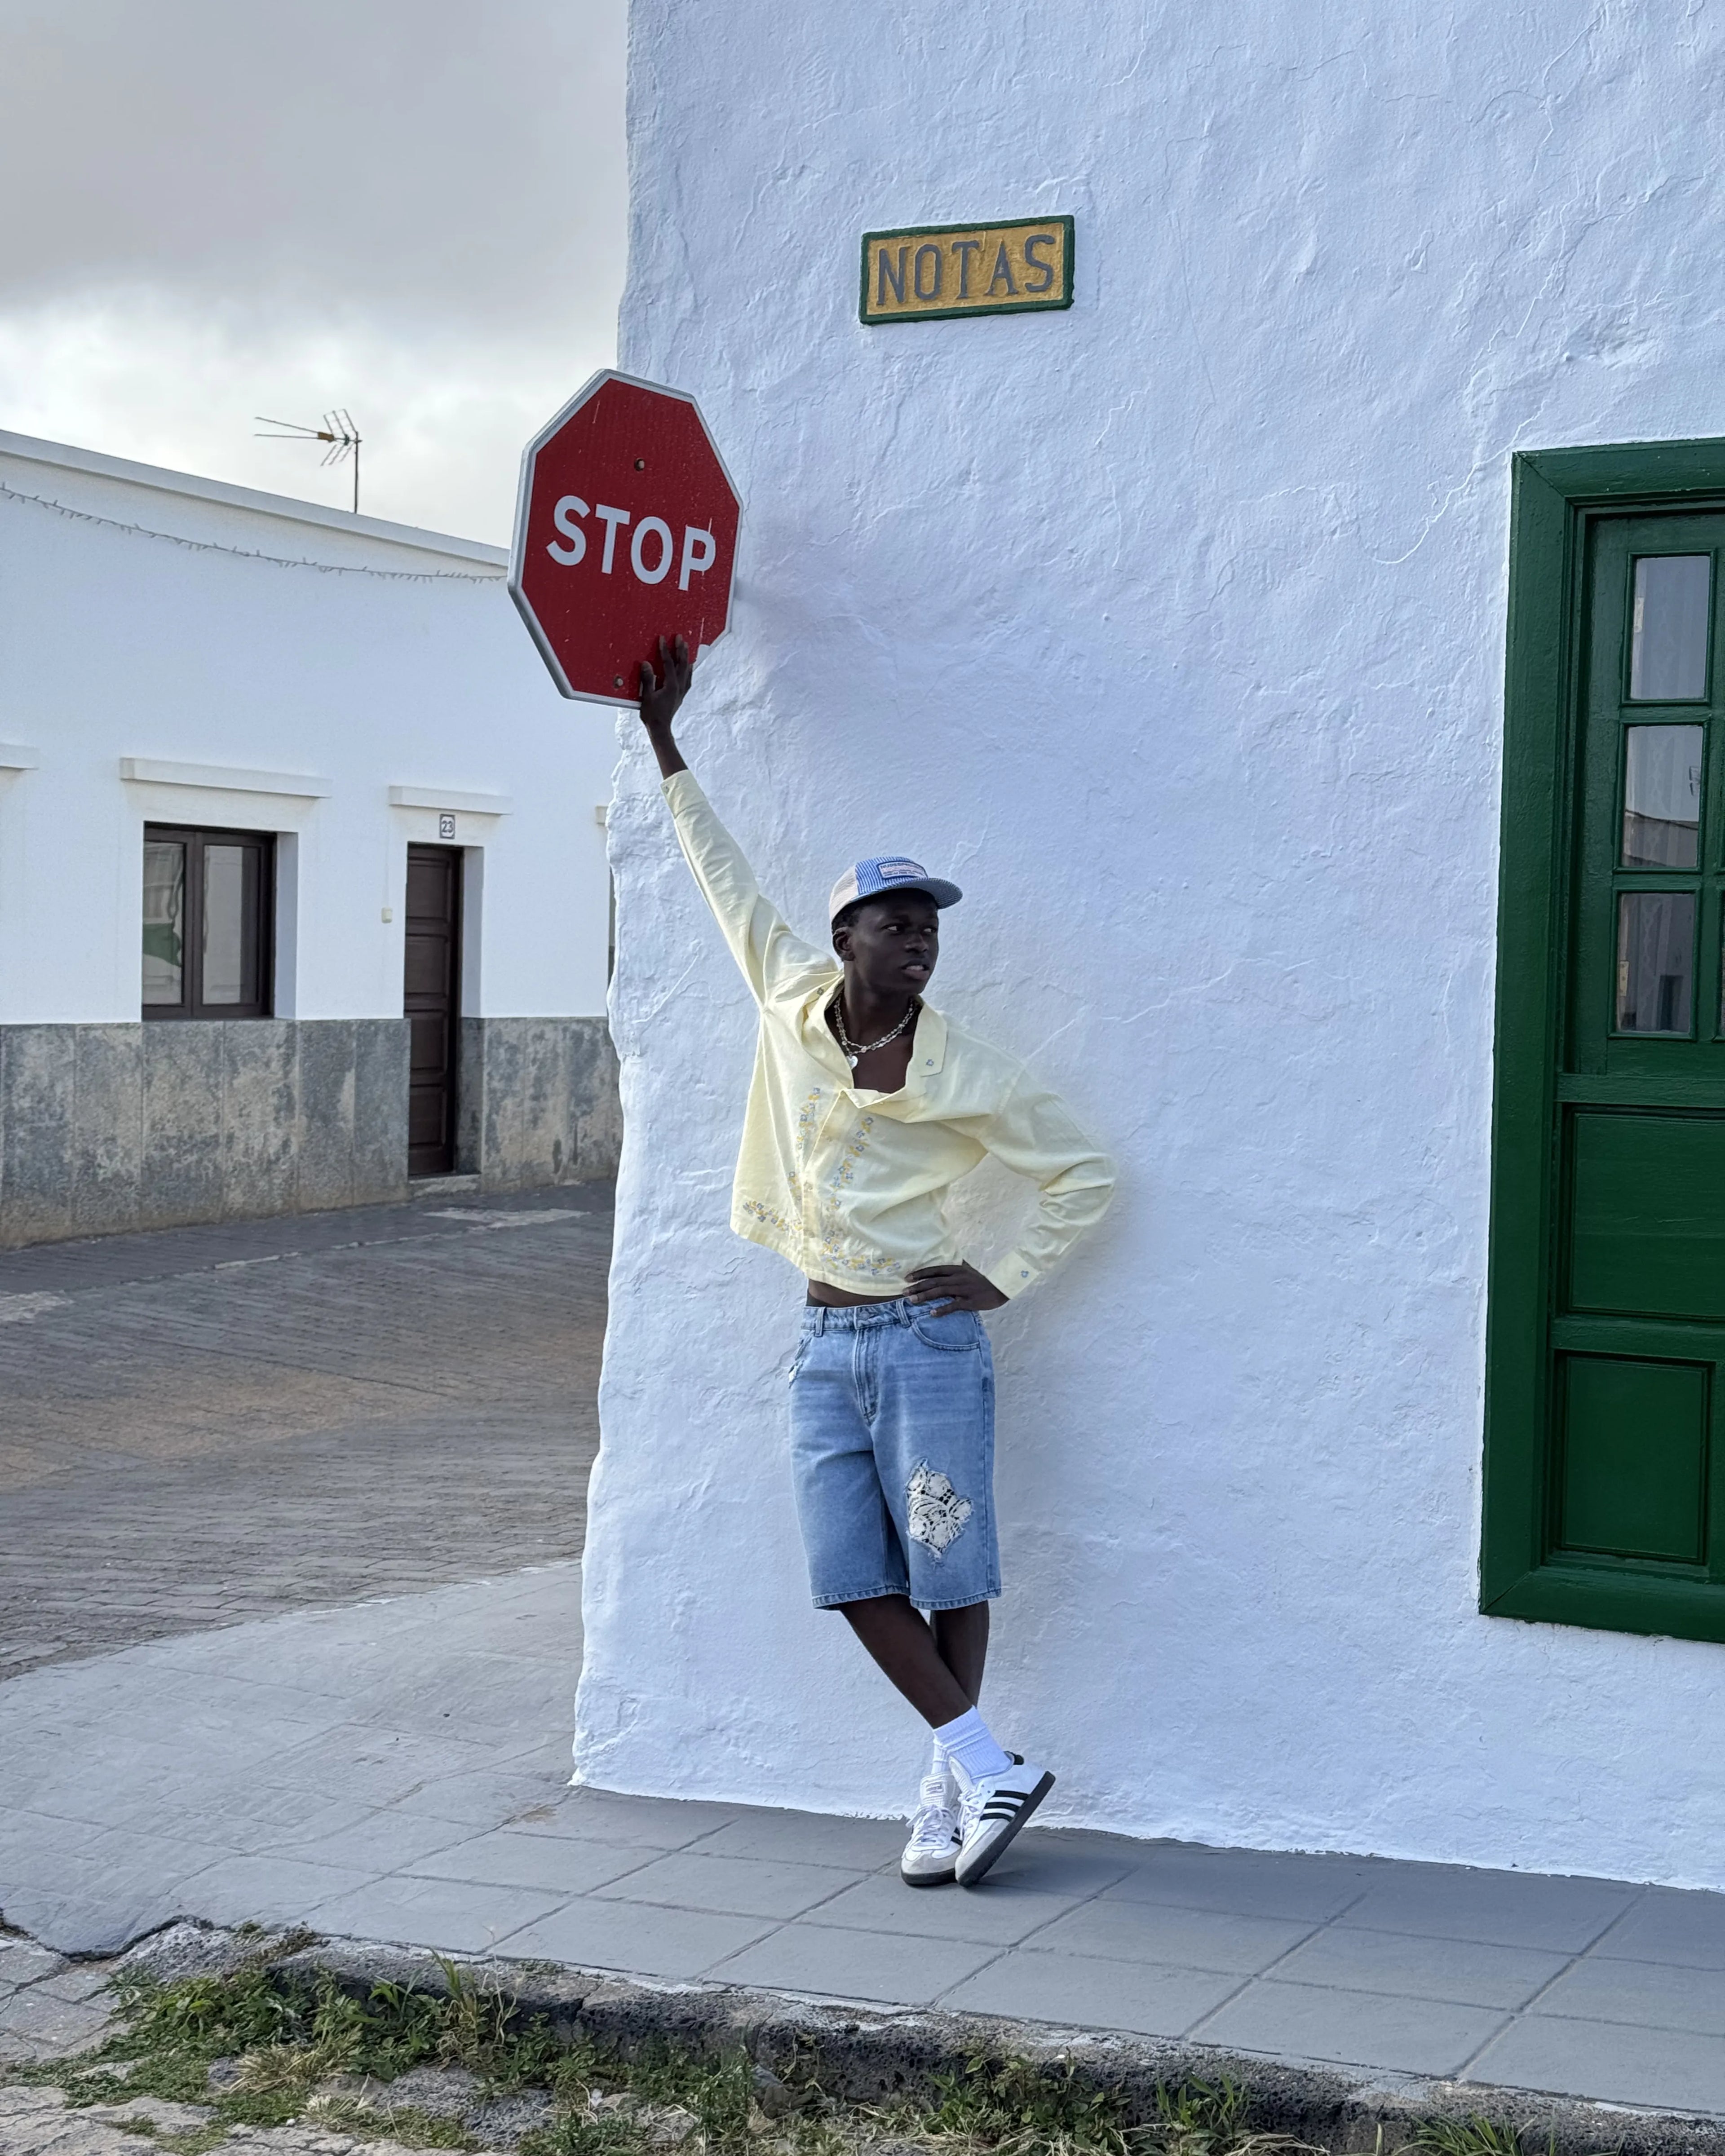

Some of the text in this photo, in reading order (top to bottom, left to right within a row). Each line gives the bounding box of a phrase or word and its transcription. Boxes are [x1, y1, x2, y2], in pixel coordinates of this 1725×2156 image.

[876, 234, 1055, 305] NOTAS
[546, 495, 716, 591] STOP
[442, 820, 453, 833] 23
